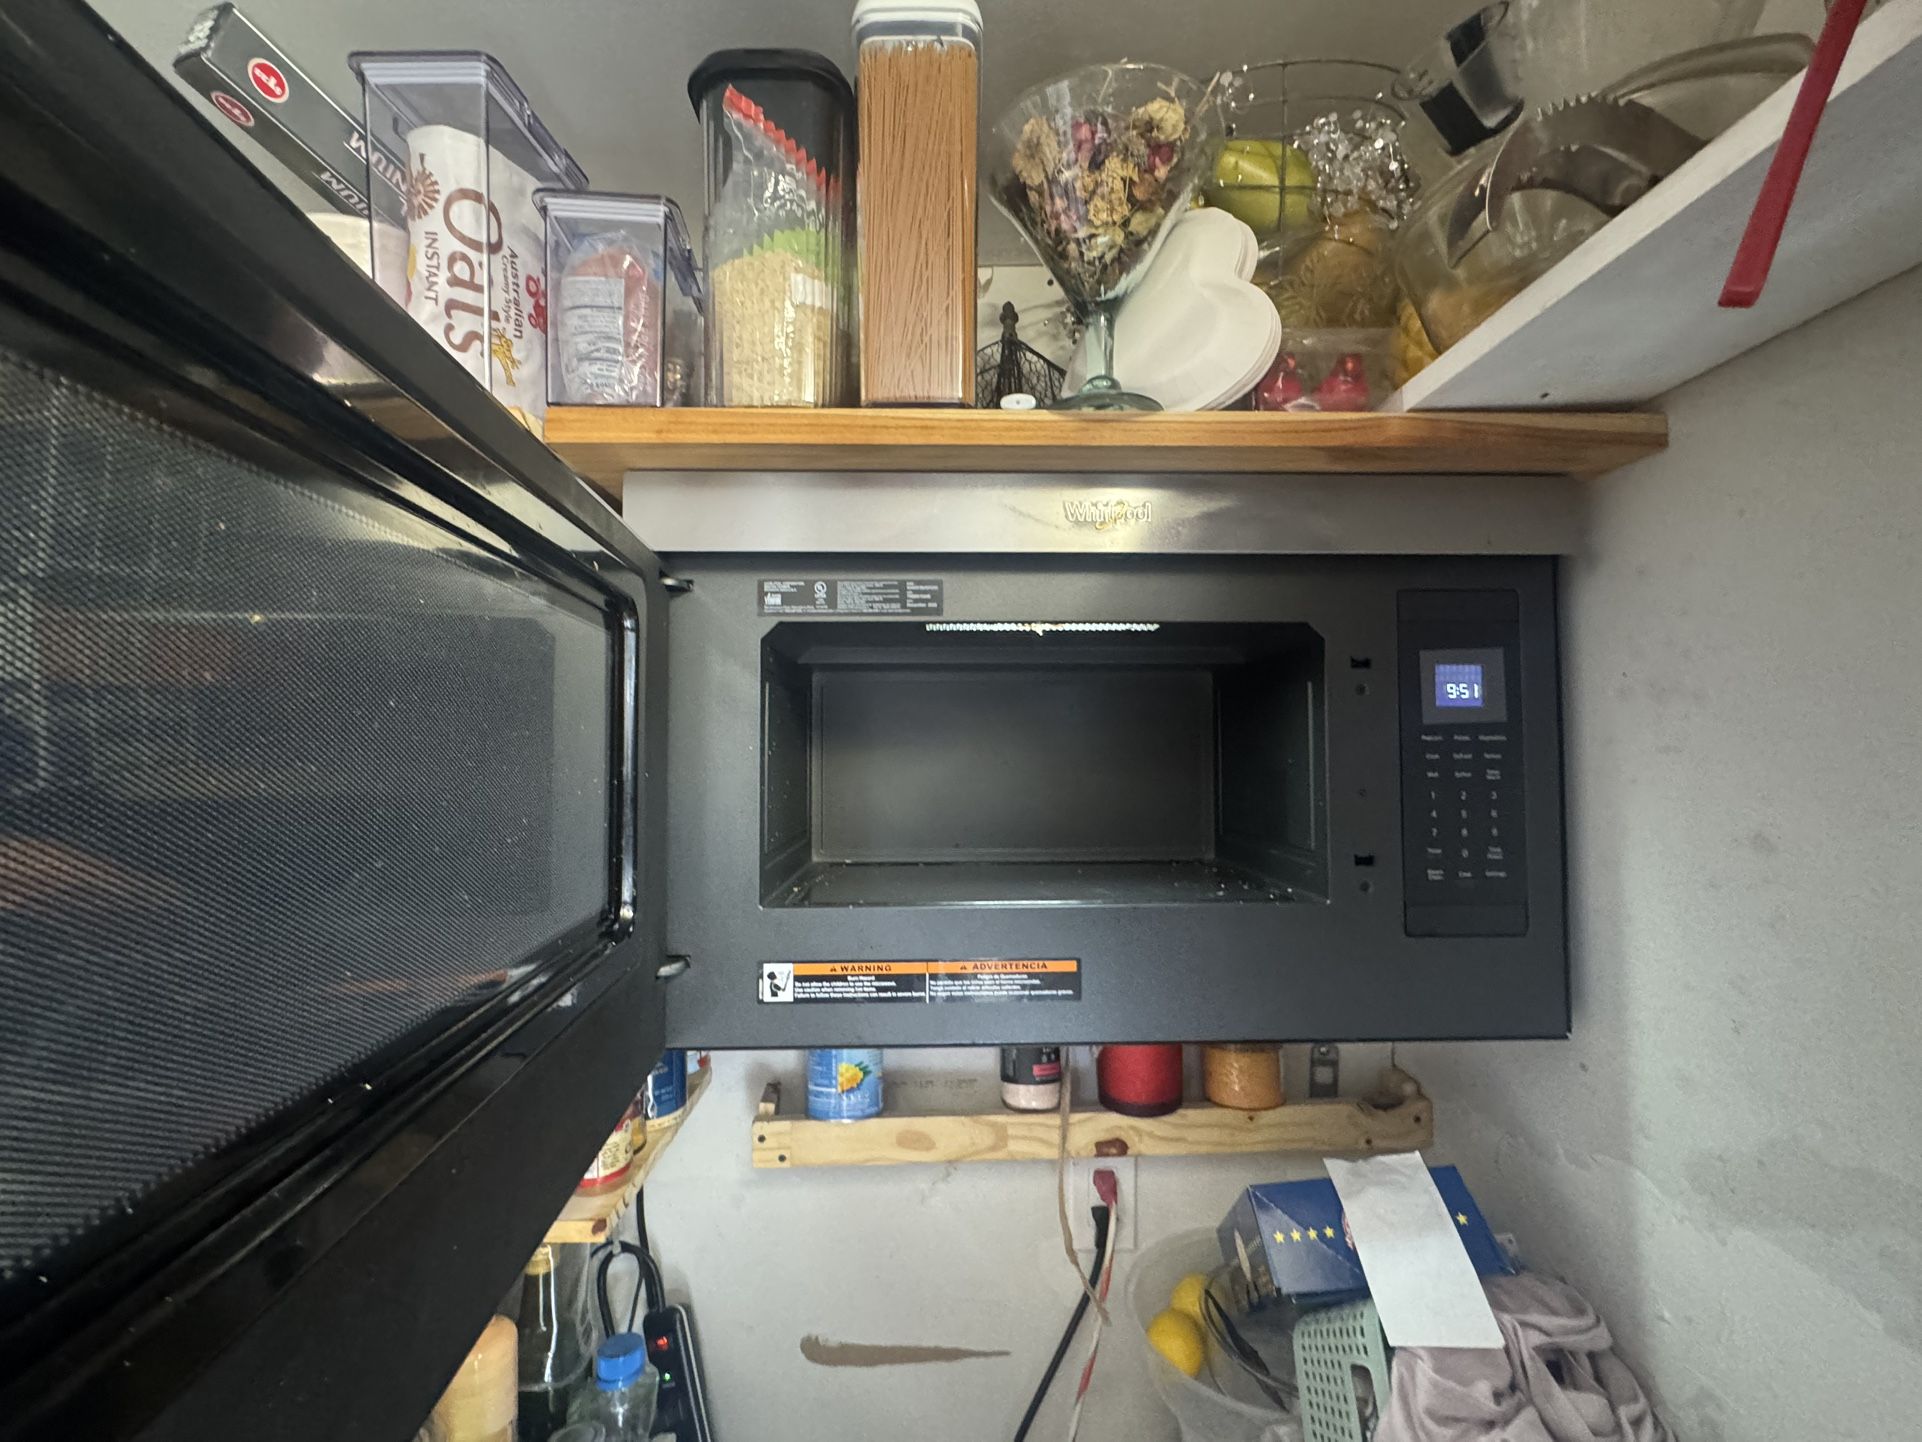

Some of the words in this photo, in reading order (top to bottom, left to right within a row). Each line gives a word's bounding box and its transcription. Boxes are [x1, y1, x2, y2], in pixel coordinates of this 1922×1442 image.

[424, 231, 440, 306] INSTANT
[508, 246, 523, 339] Australian
[1063, 500, 1152, 526] Whirlpool
[1446, 683, 1479, 699] 9:51
[840, 964, 892, 973] WARNING
[972, 961, 1048, 971] ADVERTENCIA
